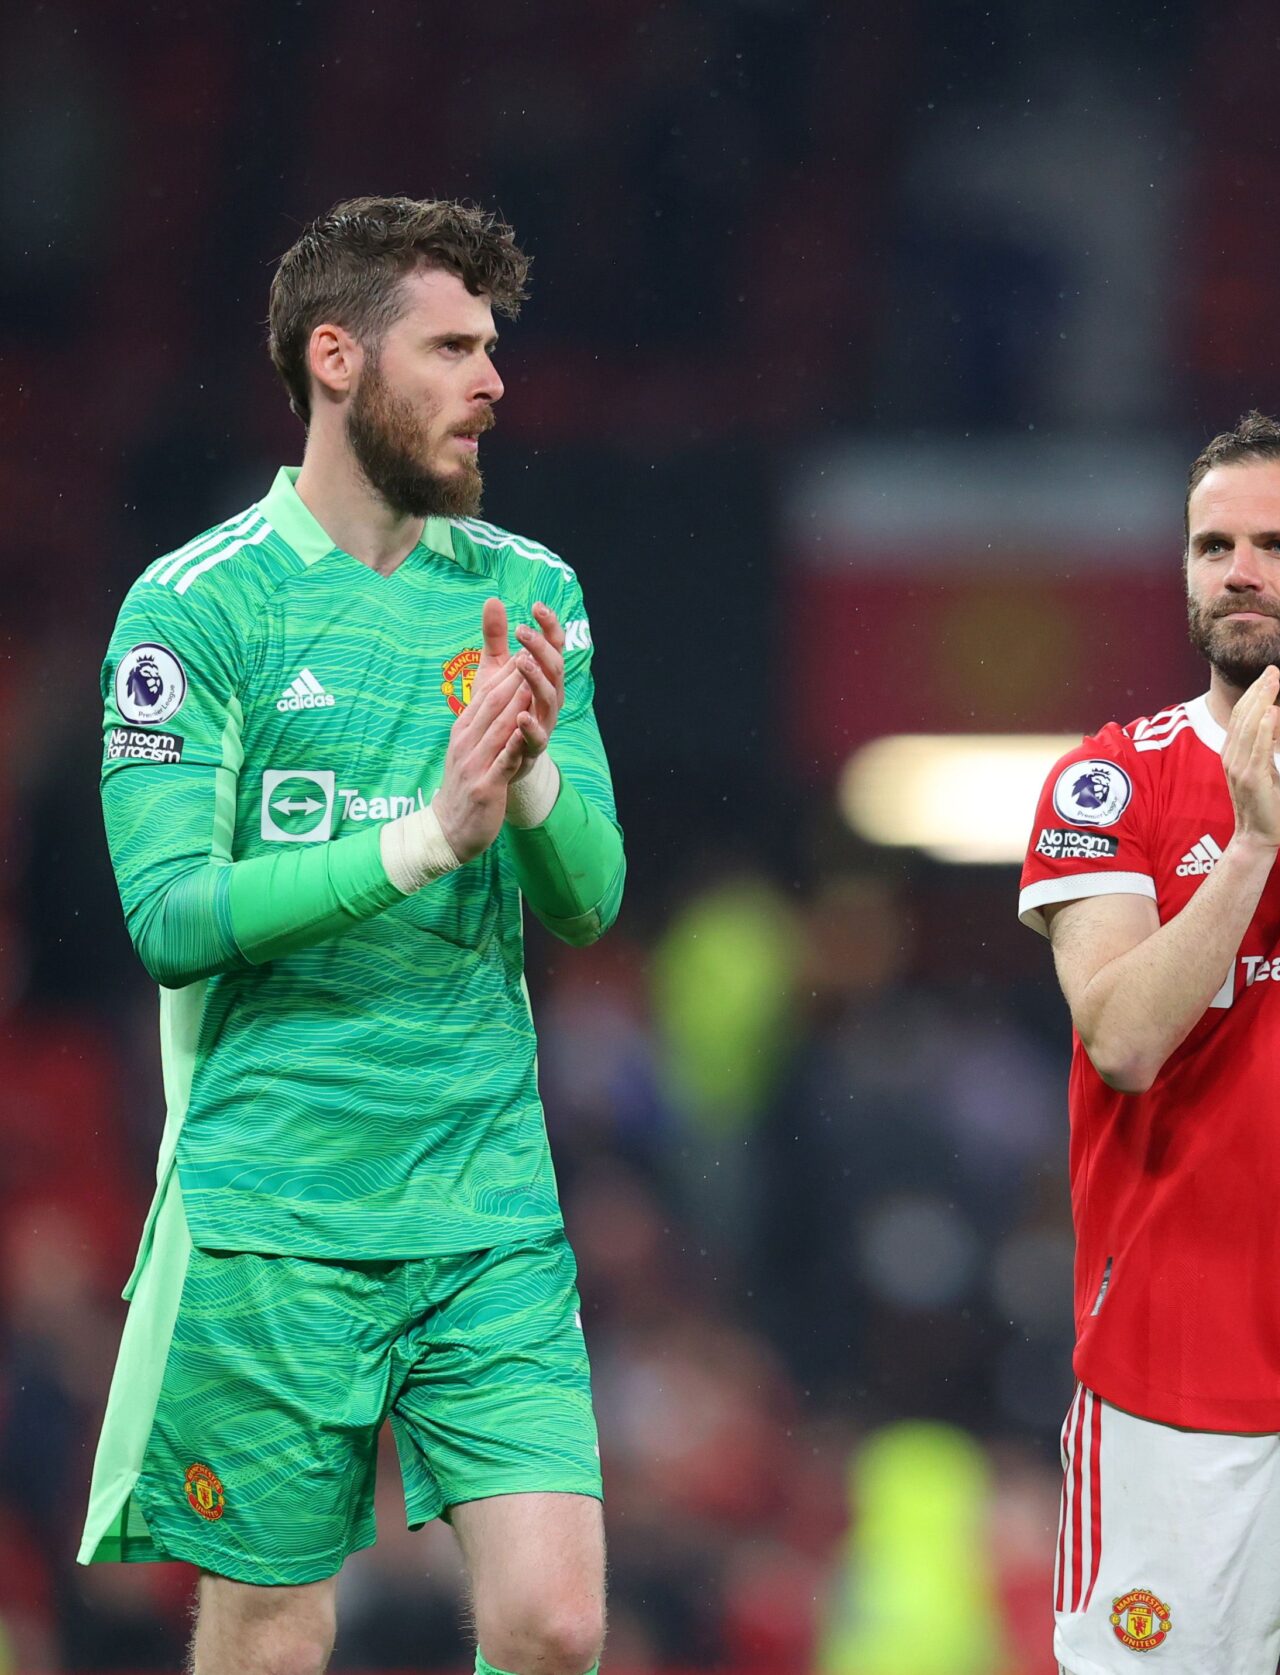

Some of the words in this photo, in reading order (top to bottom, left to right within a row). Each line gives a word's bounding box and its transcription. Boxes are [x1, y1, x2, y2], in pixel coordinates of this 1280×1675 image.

[447, 653, 479, 677] MANCH
[138, 709, 163, 718] Premier
[161, 684, 176, 710] League
[276, 693, 336, 712] adidas
[111, 729, 128, 745] No
[129, 731, 175, 750] room
[125, 745, 181, 763] racism
[338, 787, 441, 821] TeamV
[1077, 810, 1103, 819] Premier
[1039, 829, 1063, 846] No
[1063, 832, 1110, 851] room
[1175, 858, 1215, 877] adid
[1116, 1593, 1166, 1617] MANCHESTER
[1122, 1635, 1157, 1647] UNITED
